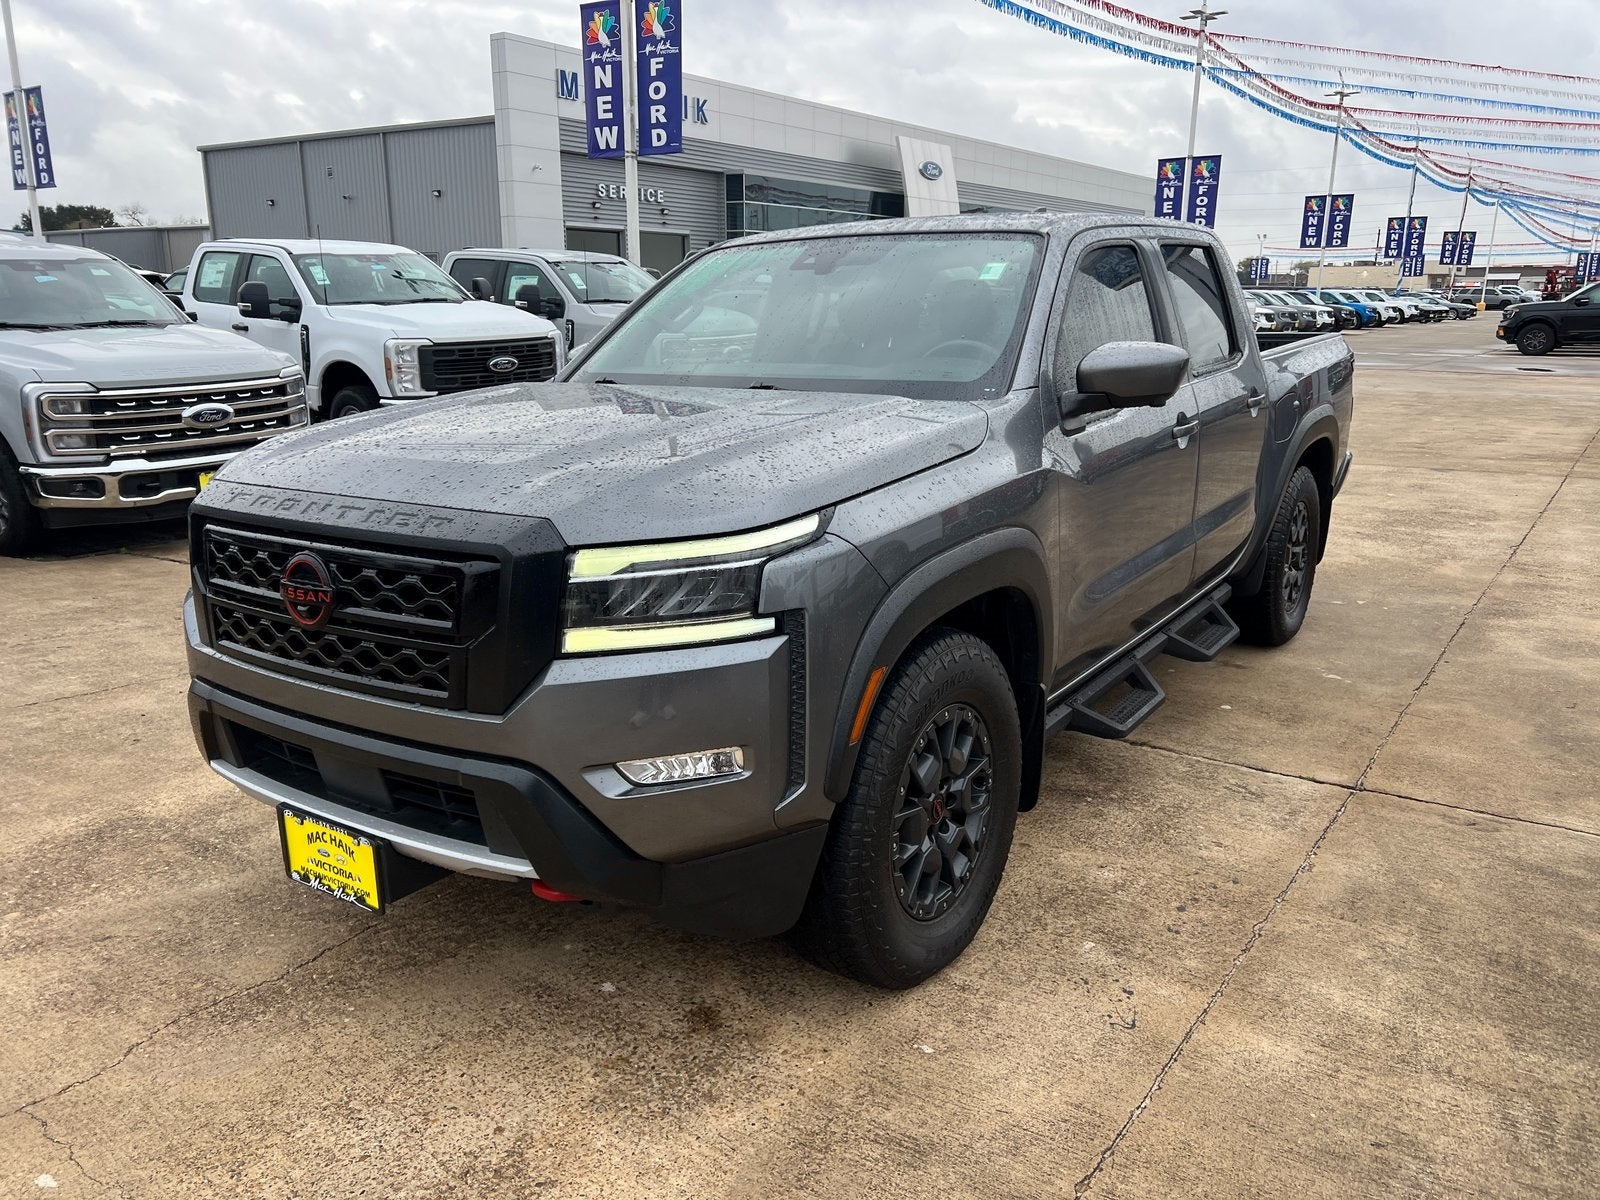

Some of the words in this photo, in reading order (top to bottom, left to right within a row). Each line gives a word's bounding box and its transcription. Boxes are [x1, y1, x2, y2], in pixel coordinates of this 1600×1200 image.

[594, 65, 618, 150] NEW
[649, 57, 667, 147] FORD
[11, 130, 27, 184] NEW
[34, 128, 49, 184] FORD
[598, 183, 664, 202] SERICE
[1305, 216, 1318, 246] NEW
[1332, 215, 1344, 246] FORD
[1388, 233, 1399, 256] NEW
[1410, 232, 1419, 256] FORD
[1443, 244, 1452, 264] NEW
[1461, 244, 1470, 264] FORD
[200, 410, 222, 422] Ford
[225, 491, 454, 531] FRONTIER
[307, 832, 328, 845] MAC
[330, 833, 356, 862] HAIK
[313, 857, 354, 881] VICTORIA
